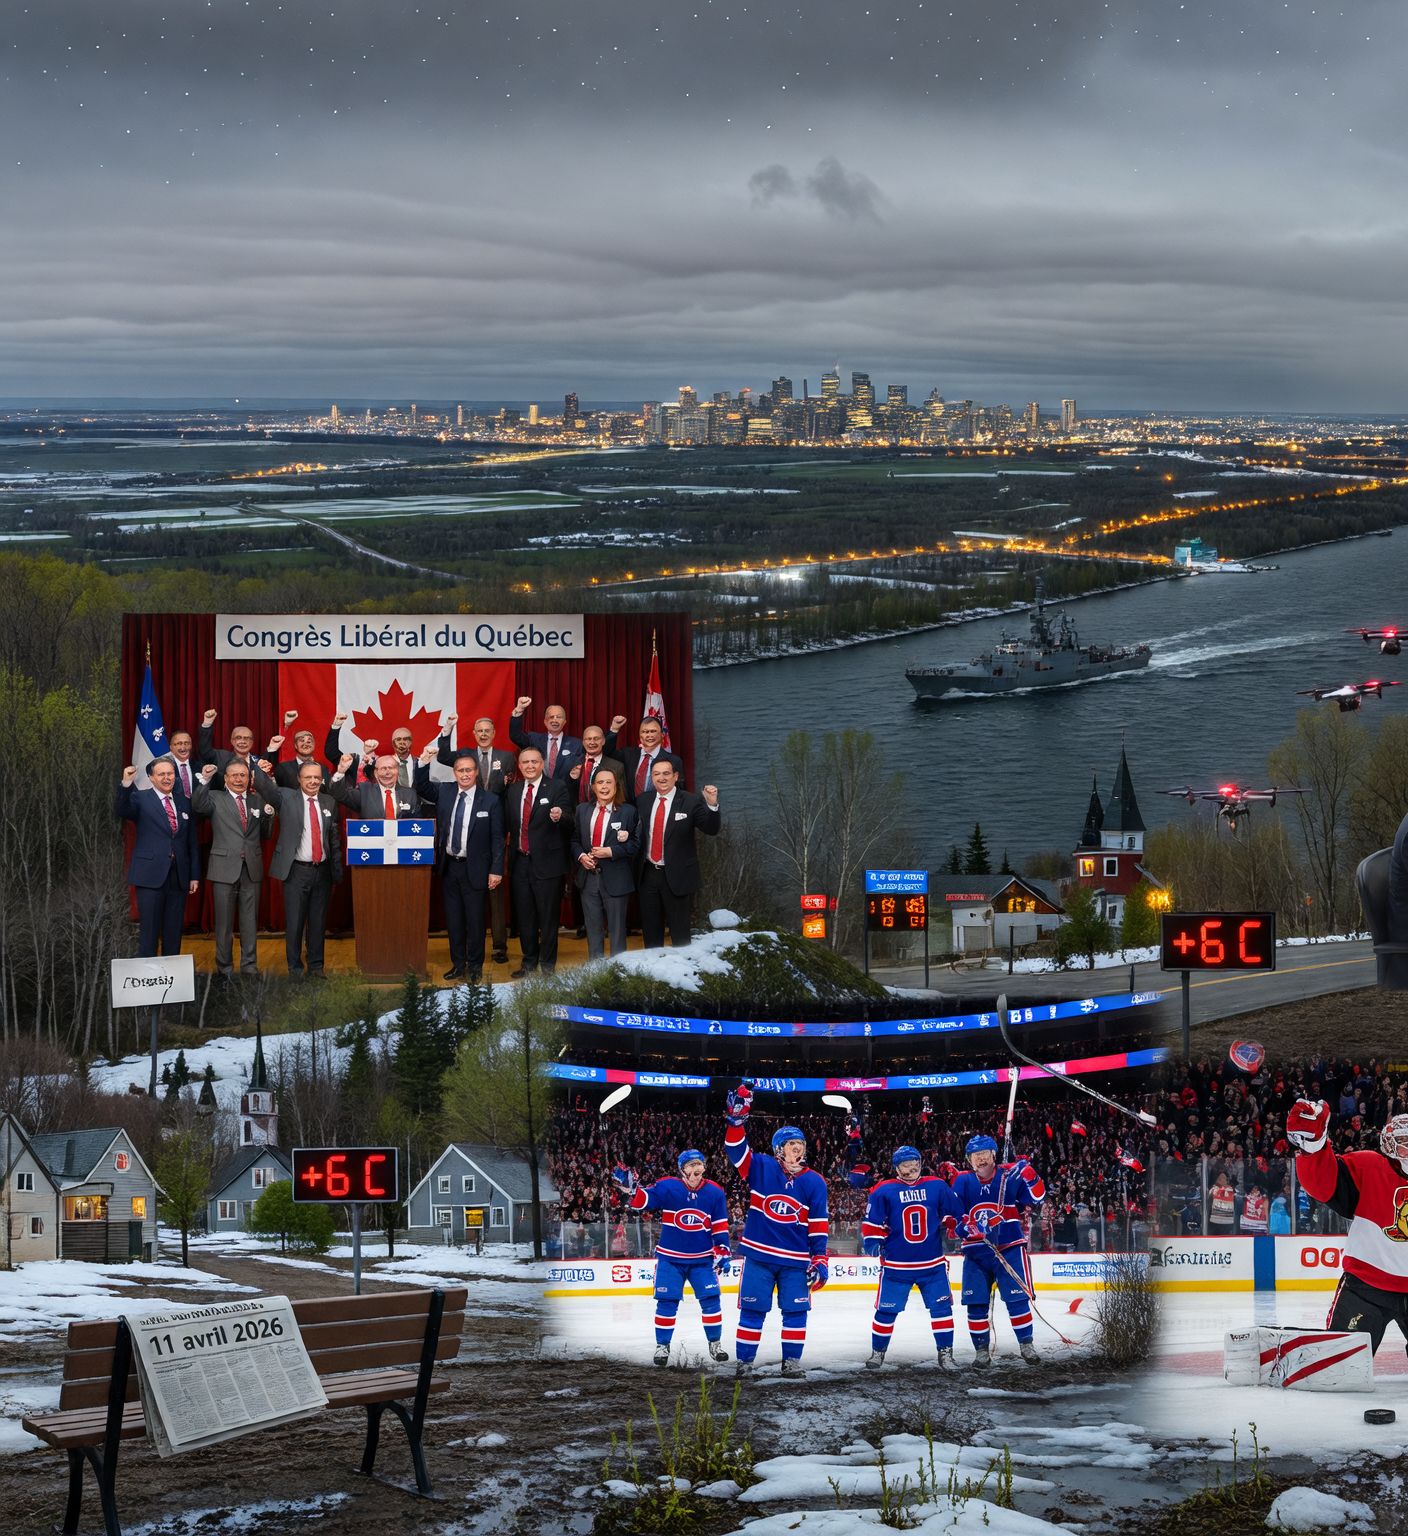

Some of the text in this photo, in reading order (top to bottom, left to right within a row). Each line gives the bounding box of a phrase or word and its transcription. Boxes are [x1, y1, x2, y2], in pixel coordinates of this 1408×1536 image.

[227, 623, 573, 654] Congrès Libéral du Québec
[1172, 921, 1262, 963] +6 C
[301, 1154, 386, 1196] +6 C
[149, 1317, 284, 1356] 11 avril 2026
